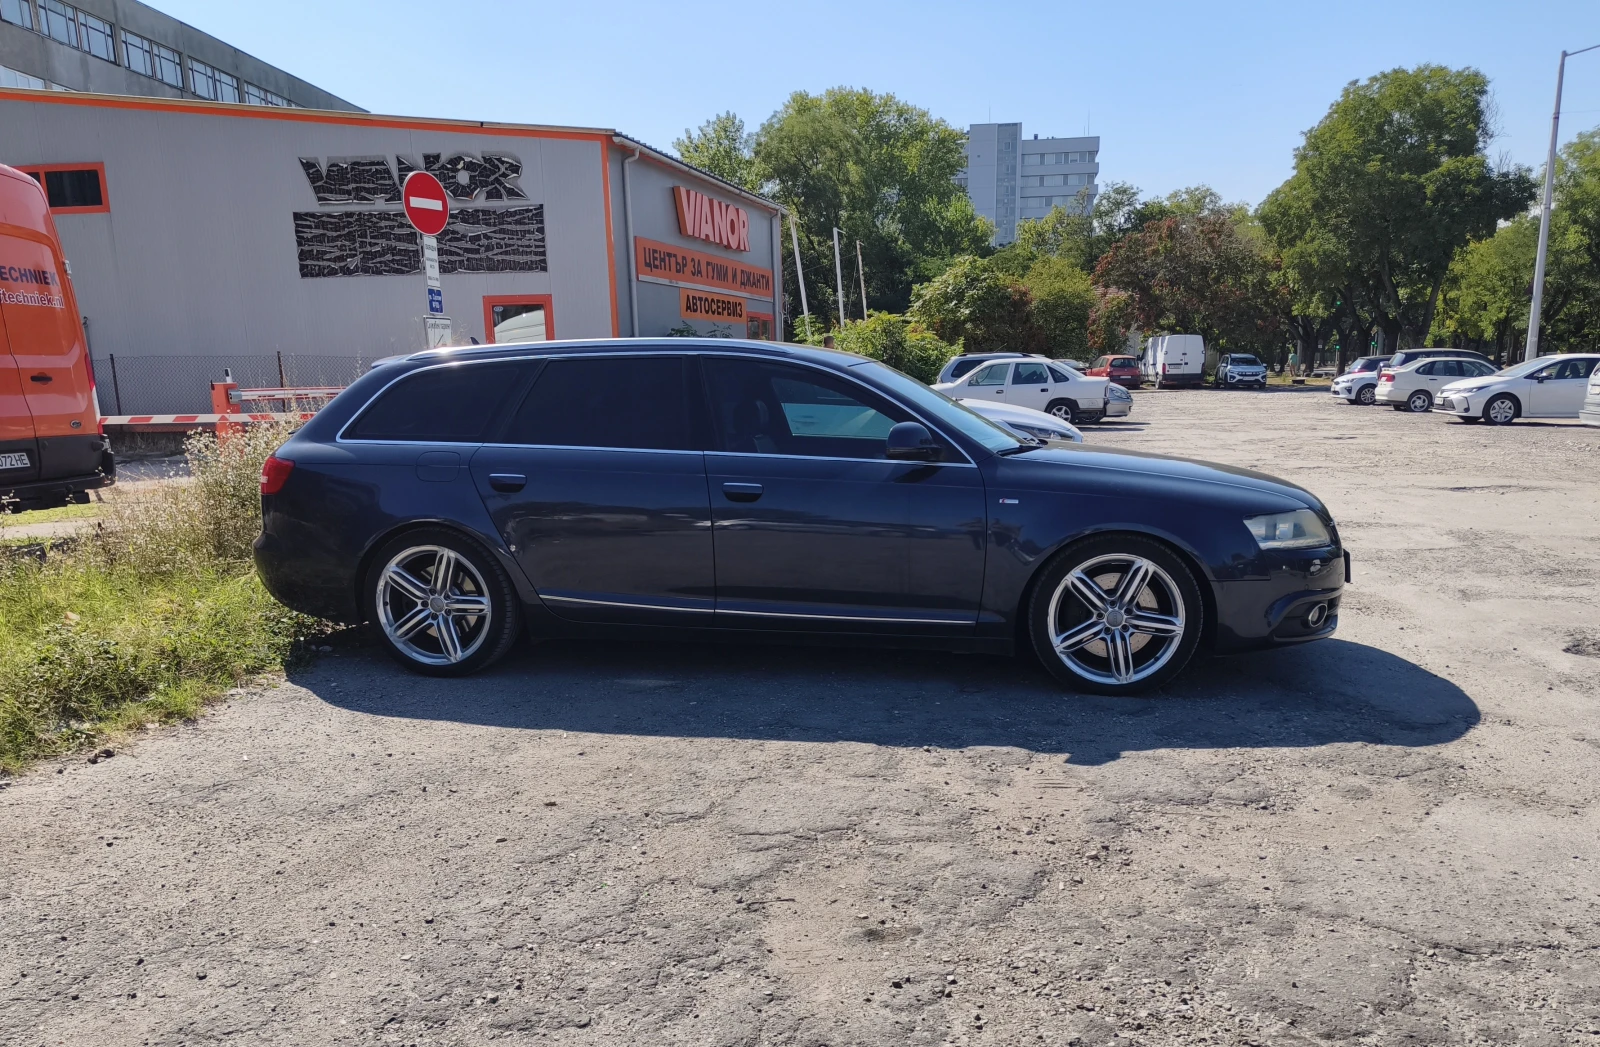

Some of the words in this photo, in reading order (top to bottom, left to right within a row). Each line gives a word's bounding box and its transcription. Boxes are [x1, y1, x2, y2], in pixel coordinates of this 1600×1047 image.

[675, 186, 751, 252] VIANOR
[643, 246, 687, 274] ЦЕНТЪР
[690, 257, 703, 279] ЗА
[705, 260, 729, 284] ГУМИ
[731, 266, 738, 285] И
[739, 268, 770, 291] ДЖАНТИ
[685, 294, 743, 319] АВТОСЕРВИЗ
